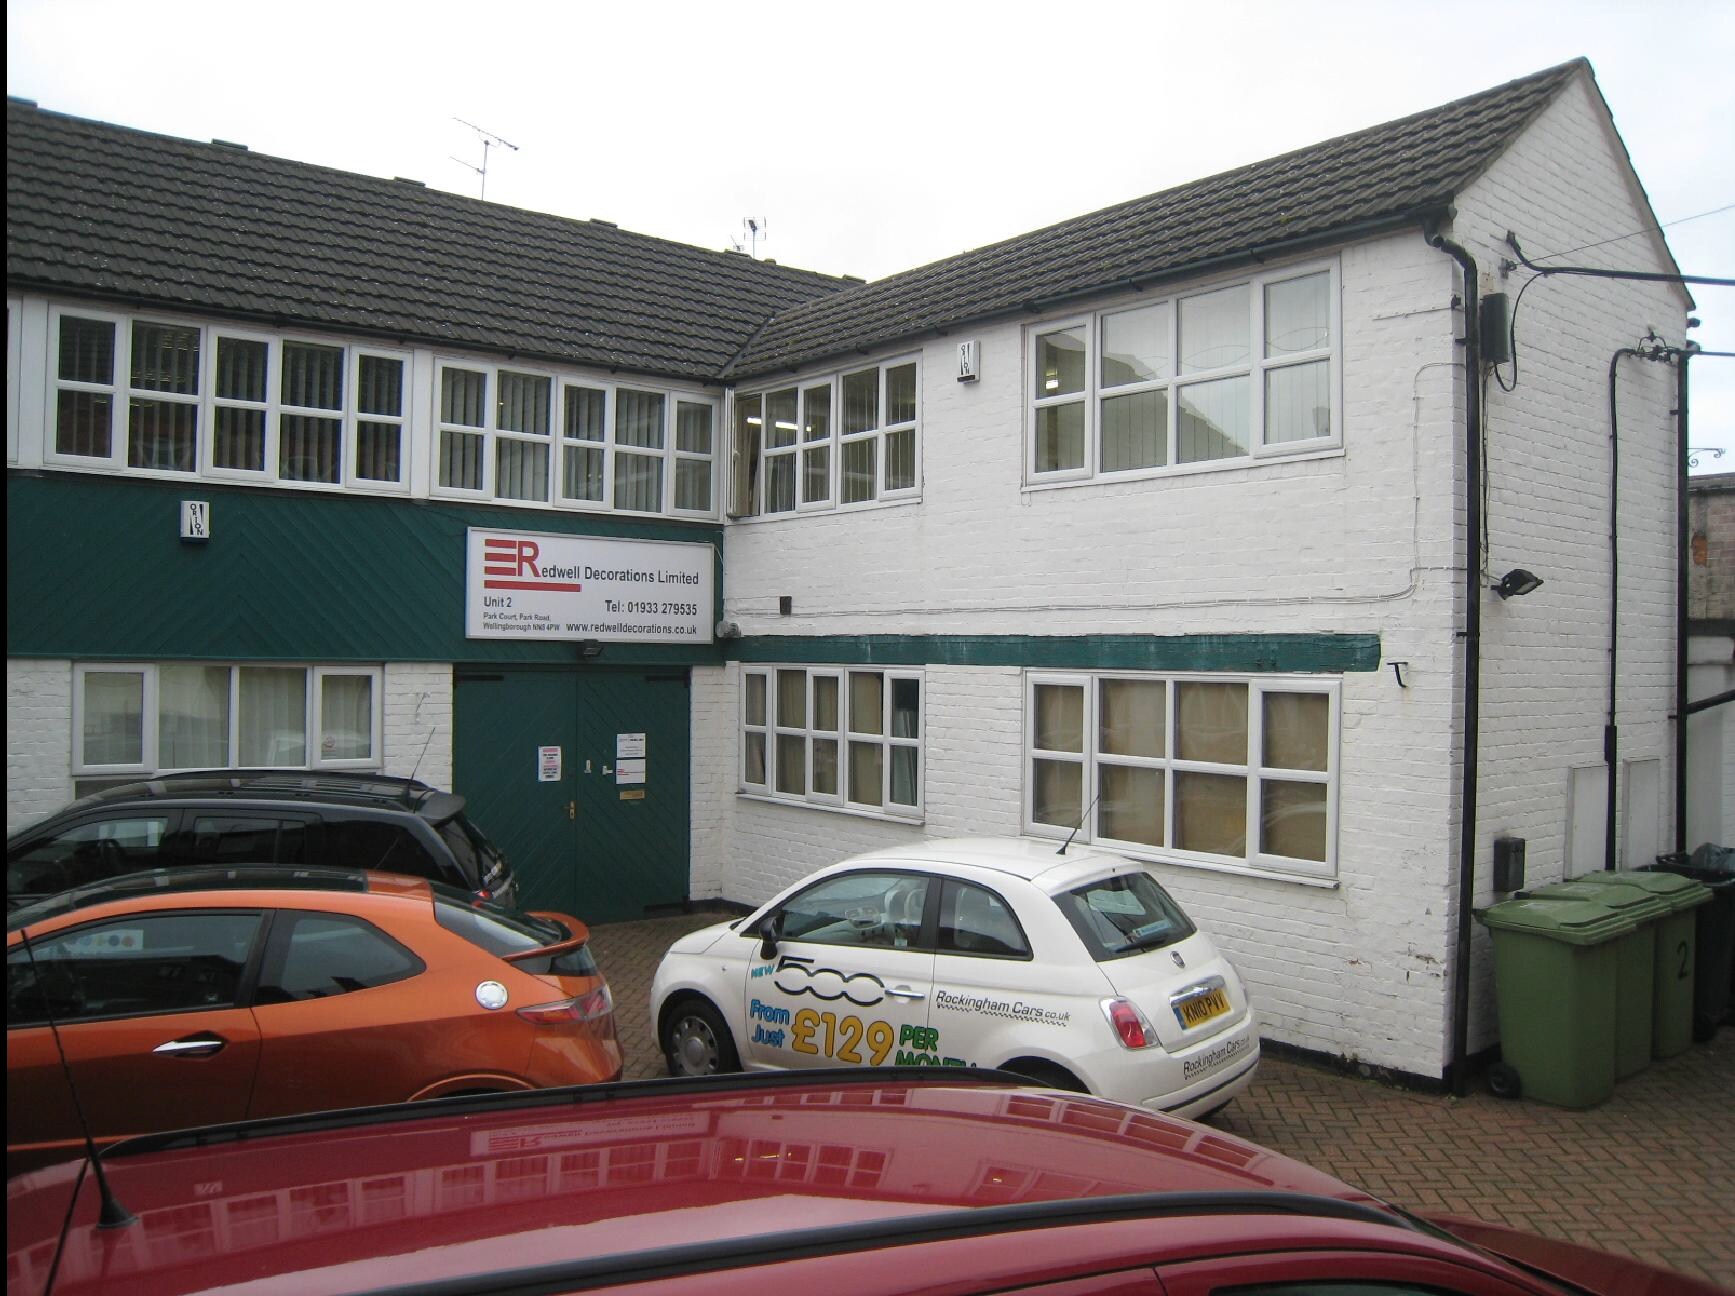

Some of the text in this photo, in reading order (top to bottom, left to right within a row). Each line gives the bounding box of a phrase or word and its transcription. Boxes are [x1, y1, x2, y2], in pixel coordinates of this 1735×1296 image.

[517, 540, 699, 585] Redwell Decorations Limited
[483, 596, 512, 608] Unit 2
[605, 599, 698, 616] Tel: 01933 279535
[483, 612, 498, 620] Park
[519, 613, 533, 621] Park
[565, 621, 697, 635] www.redwelldecorations.co.uk
[1676, 939, 1689, 980] 2
[750, 955, 886, 1009] NEW 500
[750, 998, 790, 1026] From
[935, 989, 1010, 1013] Rockingham
[1012, 1001, 1043, 1017] Cars
[751, 1023, 786, 1049] Just
[791, 1007, 895, 1067] £129
[899, 1023, 940, 1052] PER
[1183, 1047, 1226, 1076] Rockingham
